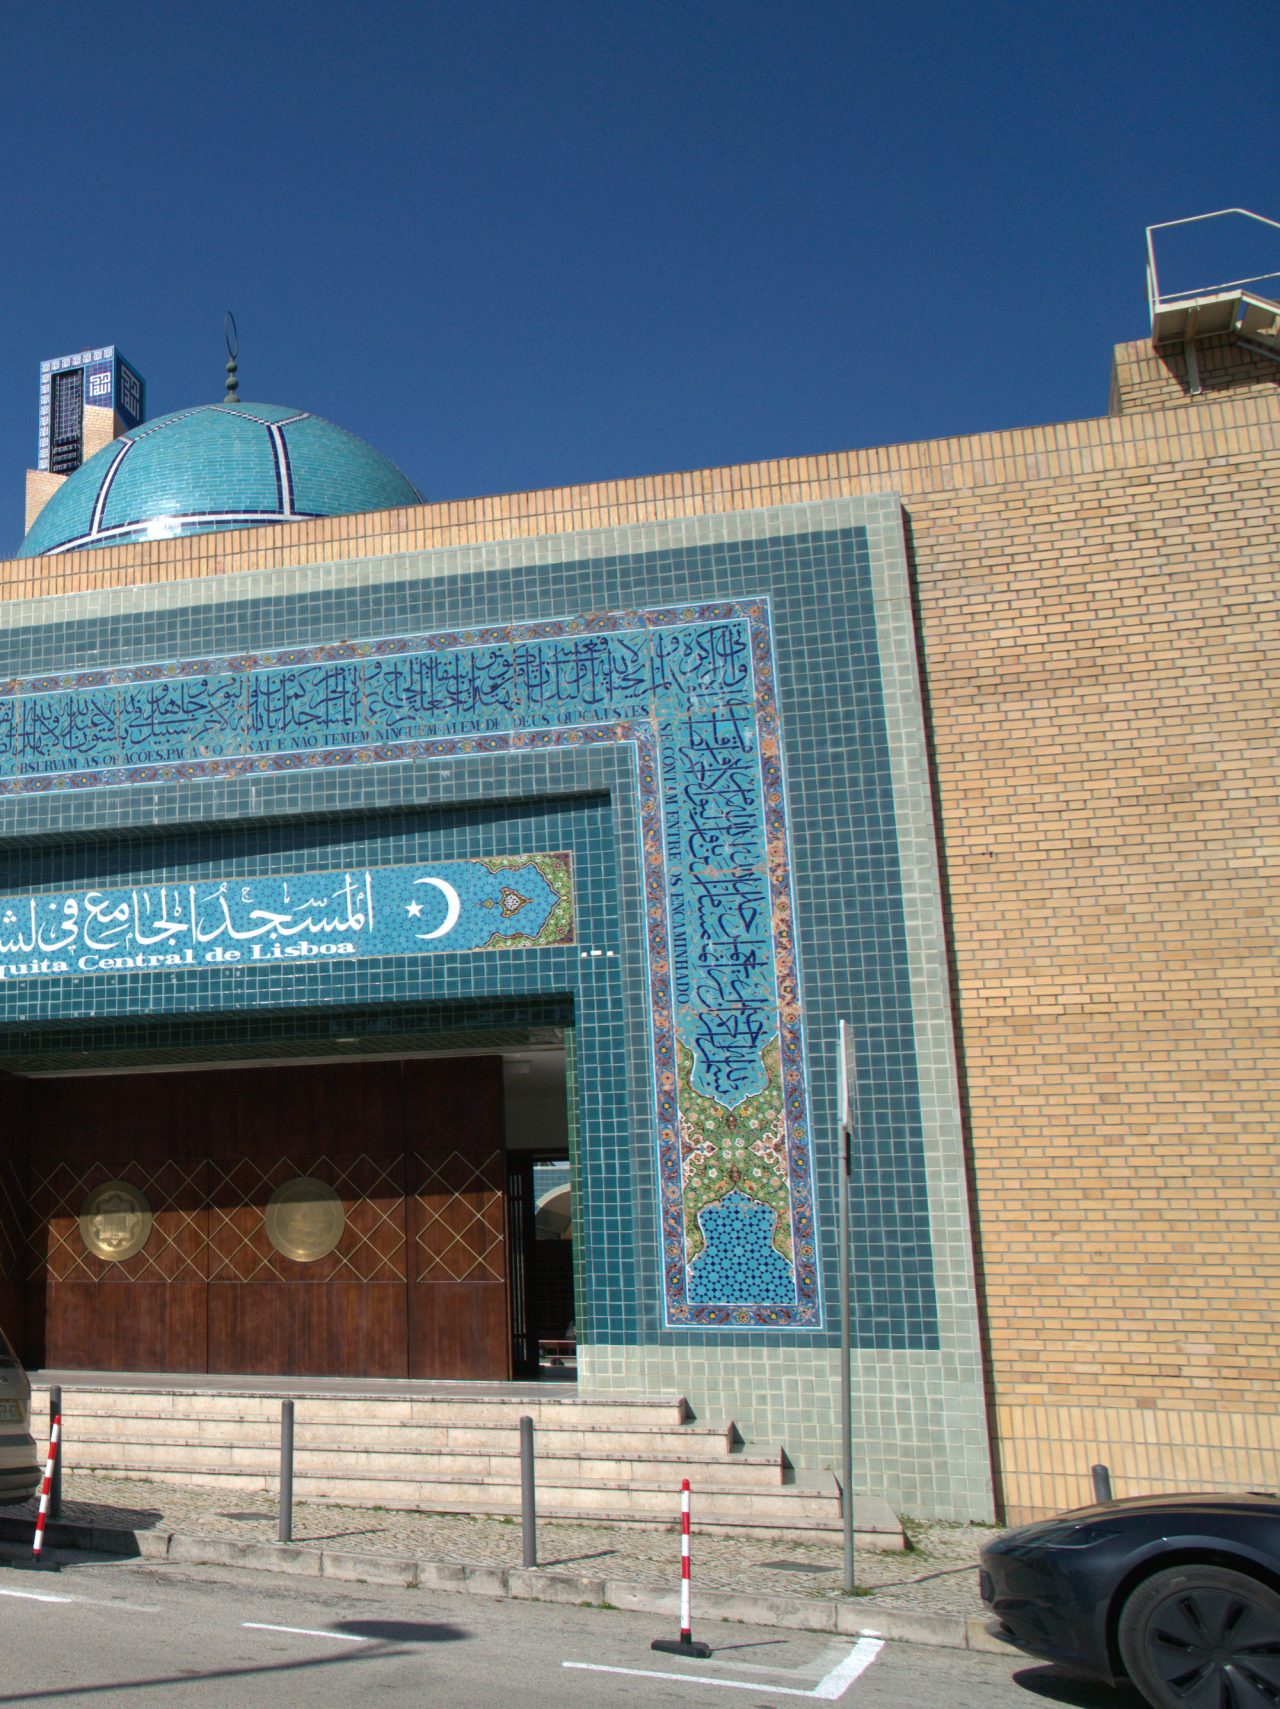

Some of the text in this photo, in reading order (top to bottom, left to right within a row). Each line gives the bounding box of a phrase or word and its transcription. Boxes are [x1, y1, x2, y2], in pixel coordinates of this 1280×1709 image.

[665, 810, 682, 862] ENTRE
[78, 949, 193, 971] Central
[205, 946, 241, 962] de
[250, 941, 356, 960] Lisboa
